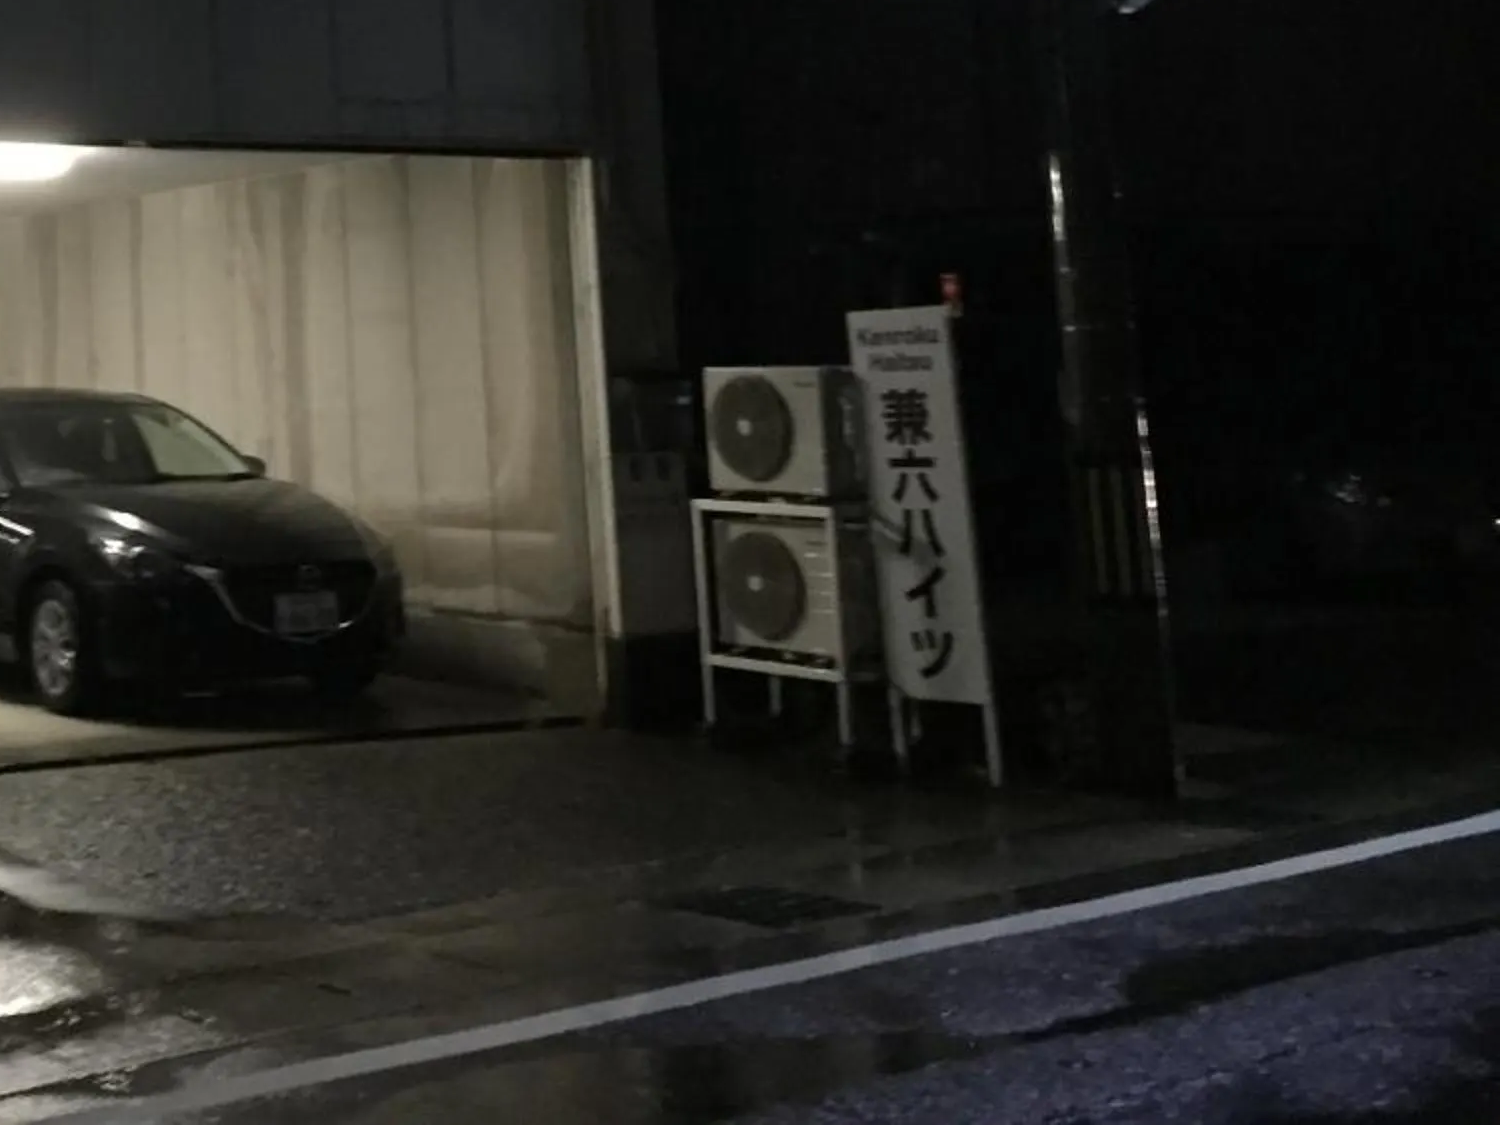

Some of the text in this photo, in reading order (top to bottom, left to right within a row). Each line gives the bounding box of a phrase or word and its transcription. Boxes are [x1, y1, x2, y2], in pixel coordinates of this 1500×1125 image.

[879, 388, 952, 678] 兼六ハイツ
